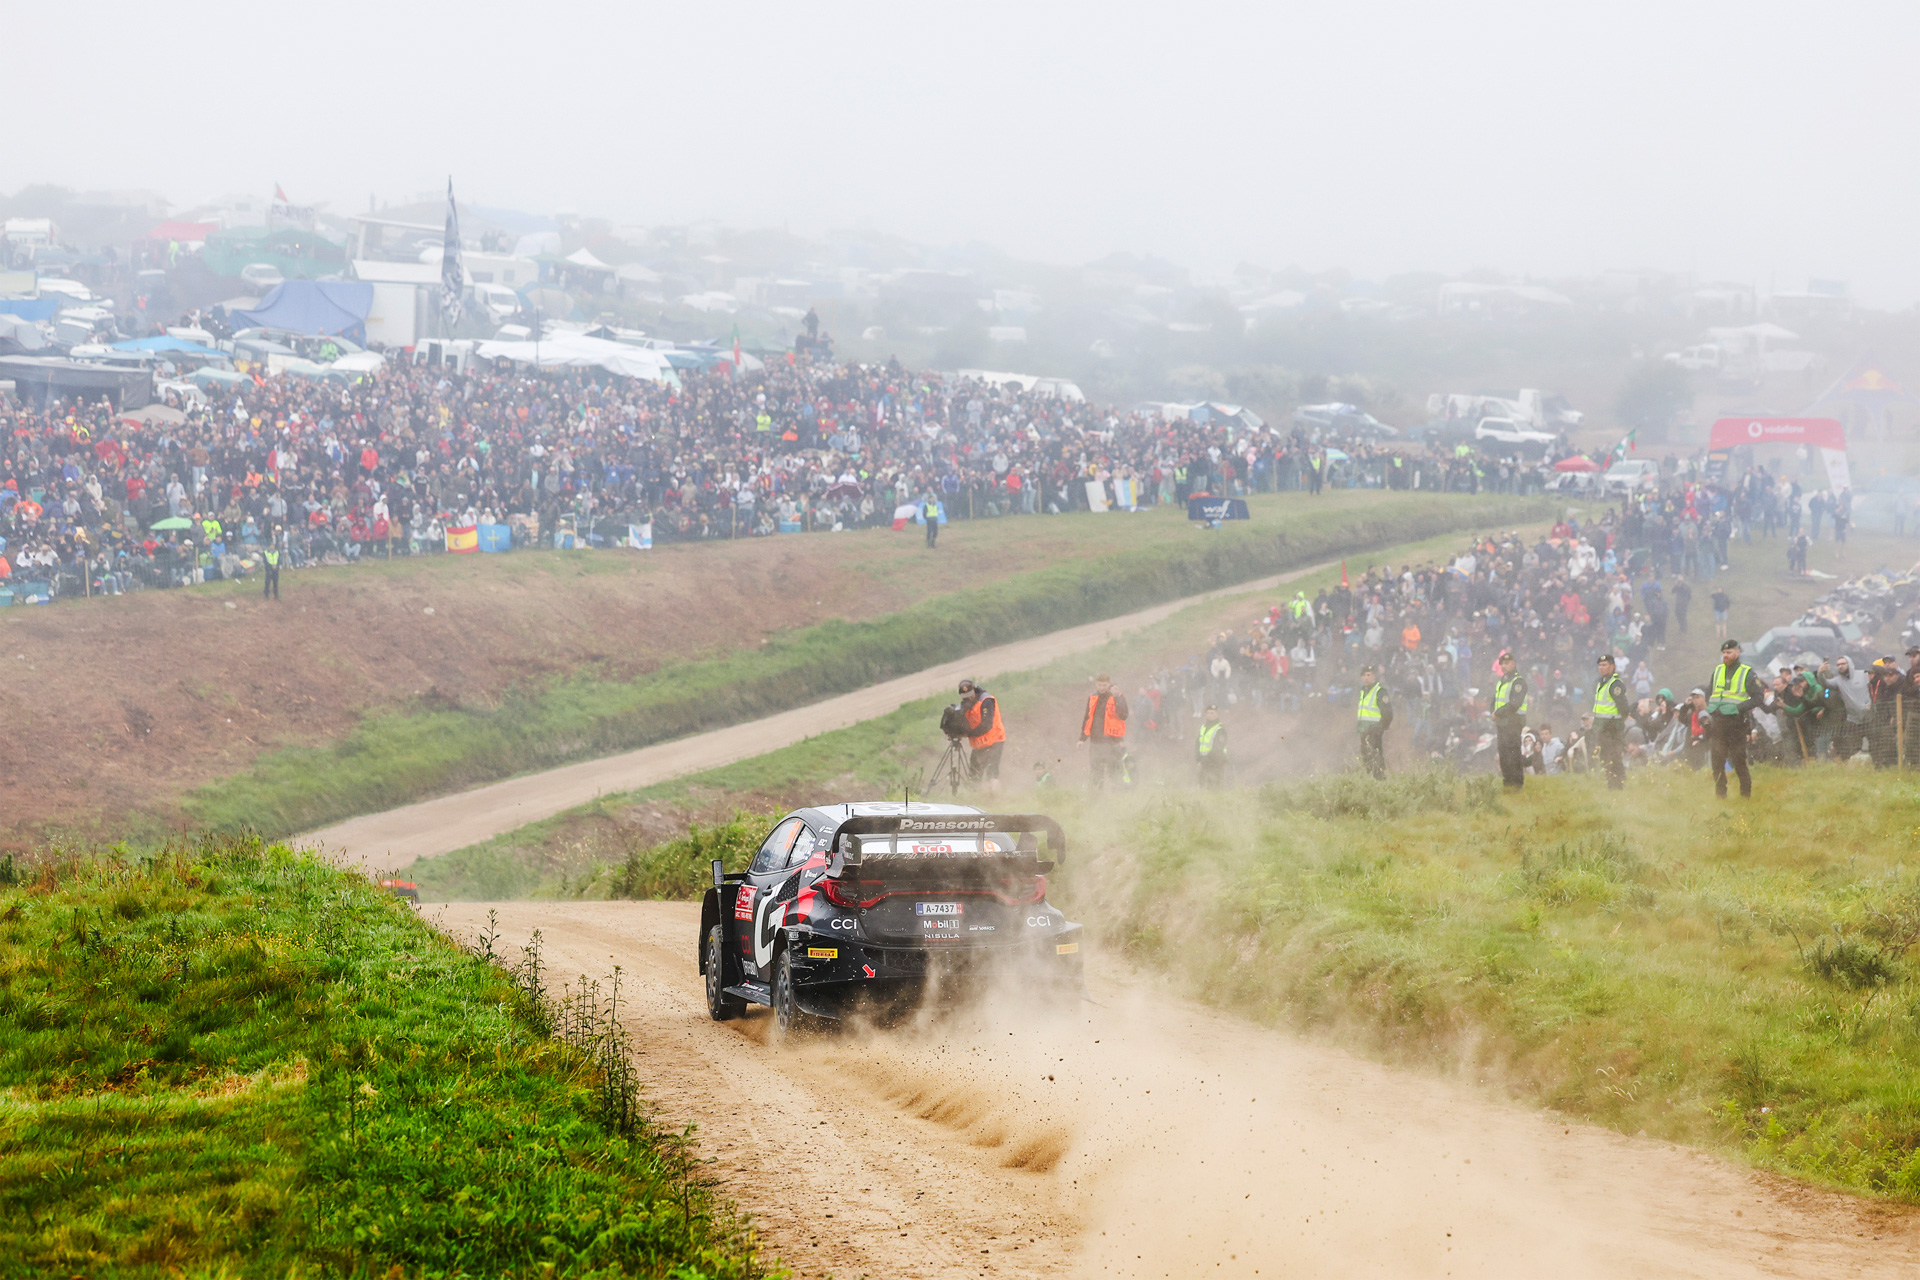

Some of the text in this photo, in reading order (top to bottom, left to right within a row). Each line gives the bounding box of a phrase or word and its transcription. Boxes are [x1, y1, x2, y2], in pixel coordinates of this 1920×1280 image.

[1764, 424, 1805, 434] vodafone
[899, 817, 996, 830] Panasonic
[925, 904, 955, 913] A-7437
[923, 920, 949, 929] Mobil
